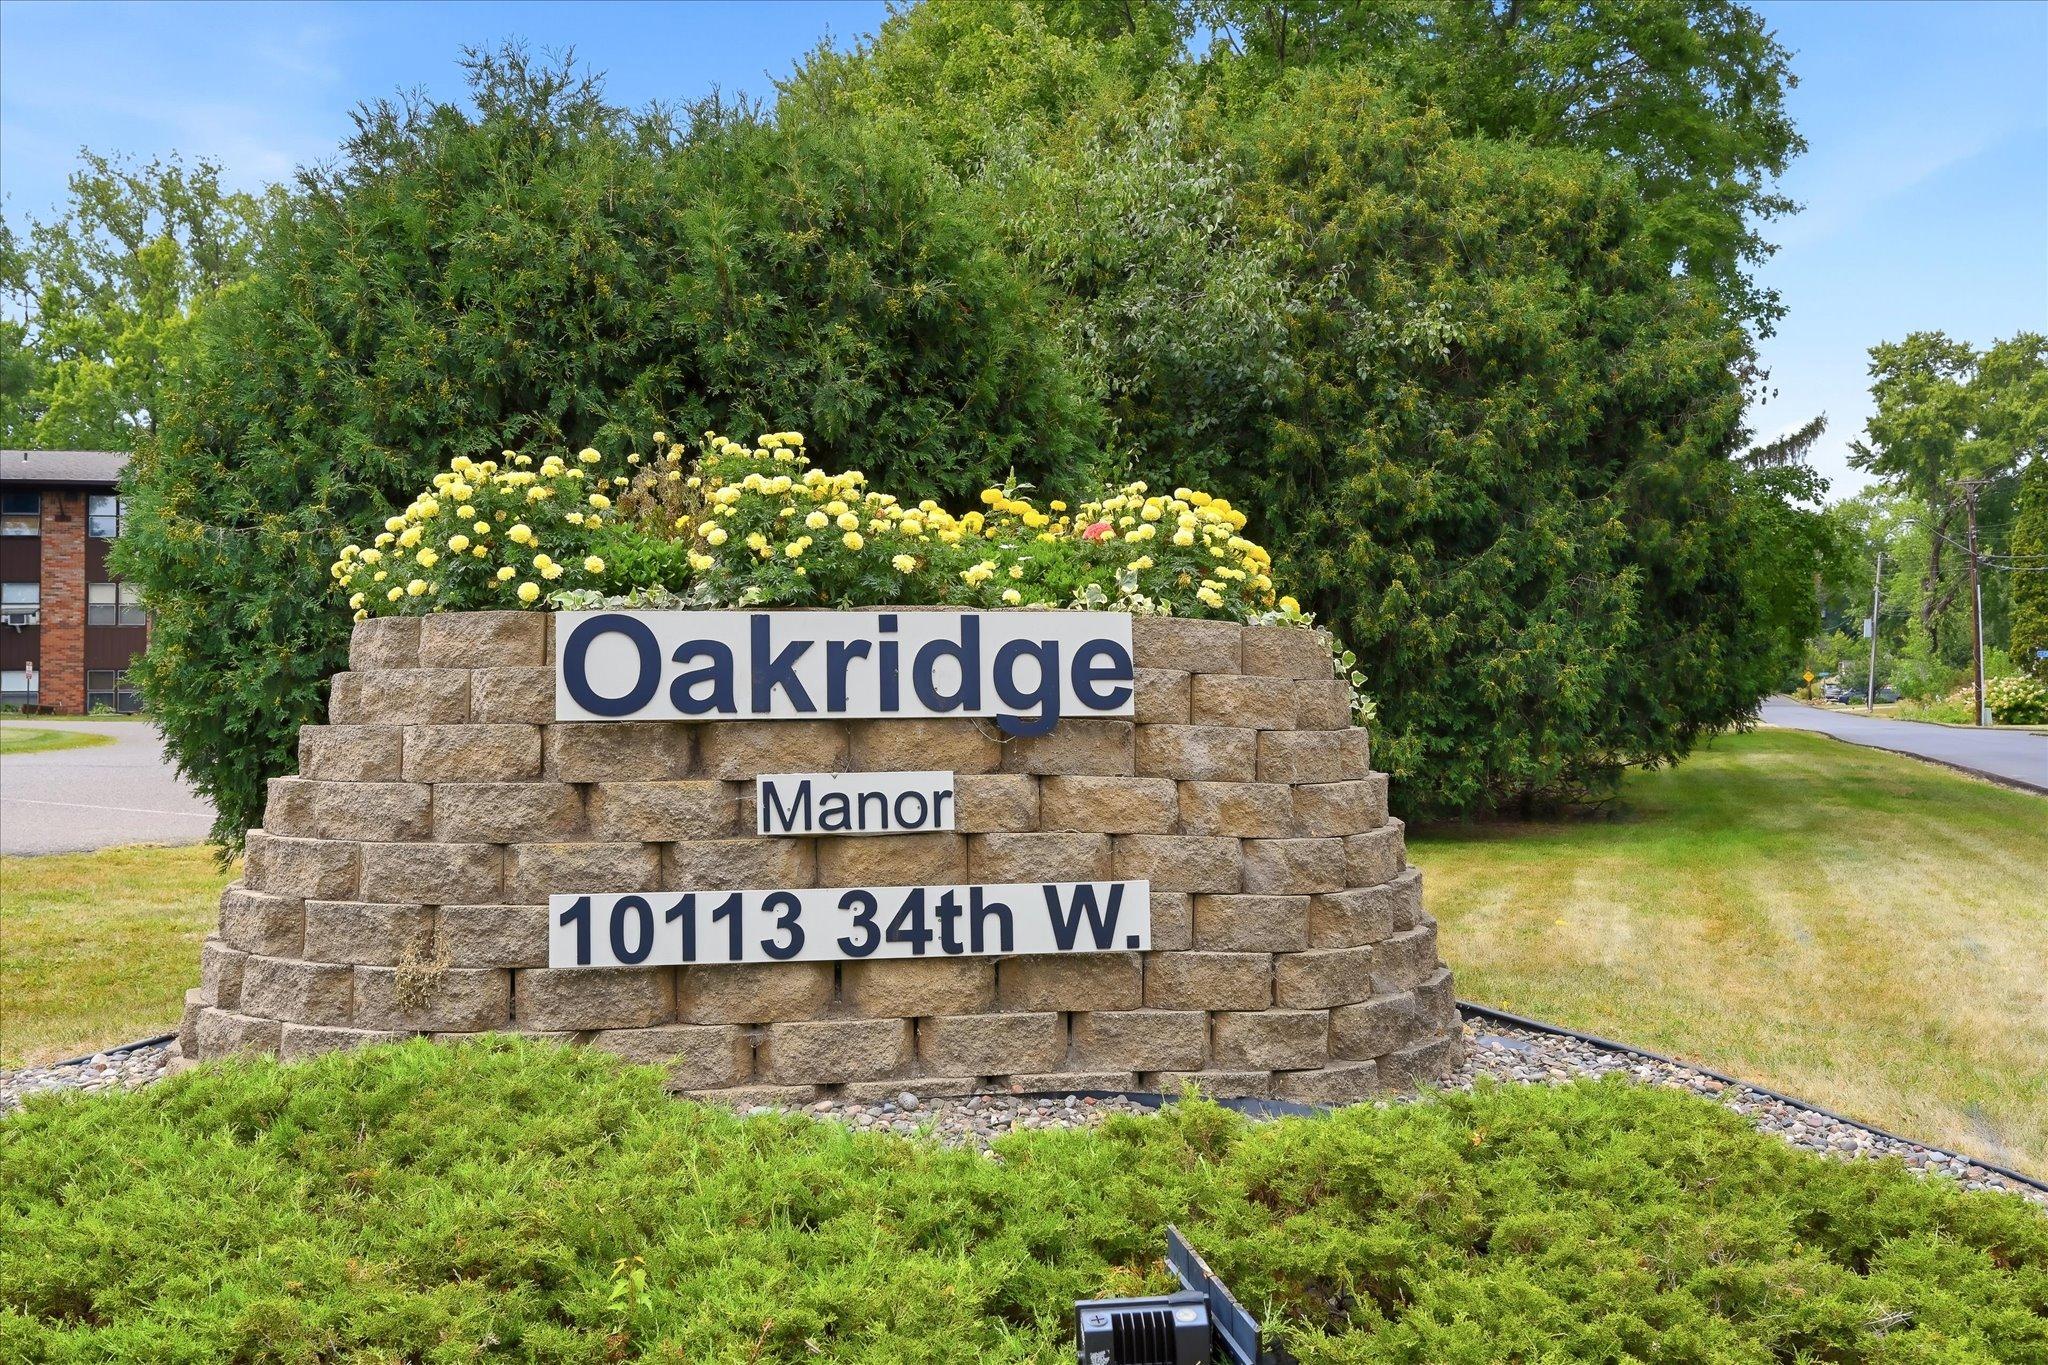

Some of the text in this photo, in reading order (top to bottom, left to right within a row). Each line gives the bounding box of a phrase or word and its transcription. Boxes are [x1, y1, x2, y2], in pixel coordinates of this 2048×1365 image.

[563, 613, 1135, 738] Oakridge
[762, 780, 952, 831] Manor
[559, 883, 1141, 966] 10113 34th W.
